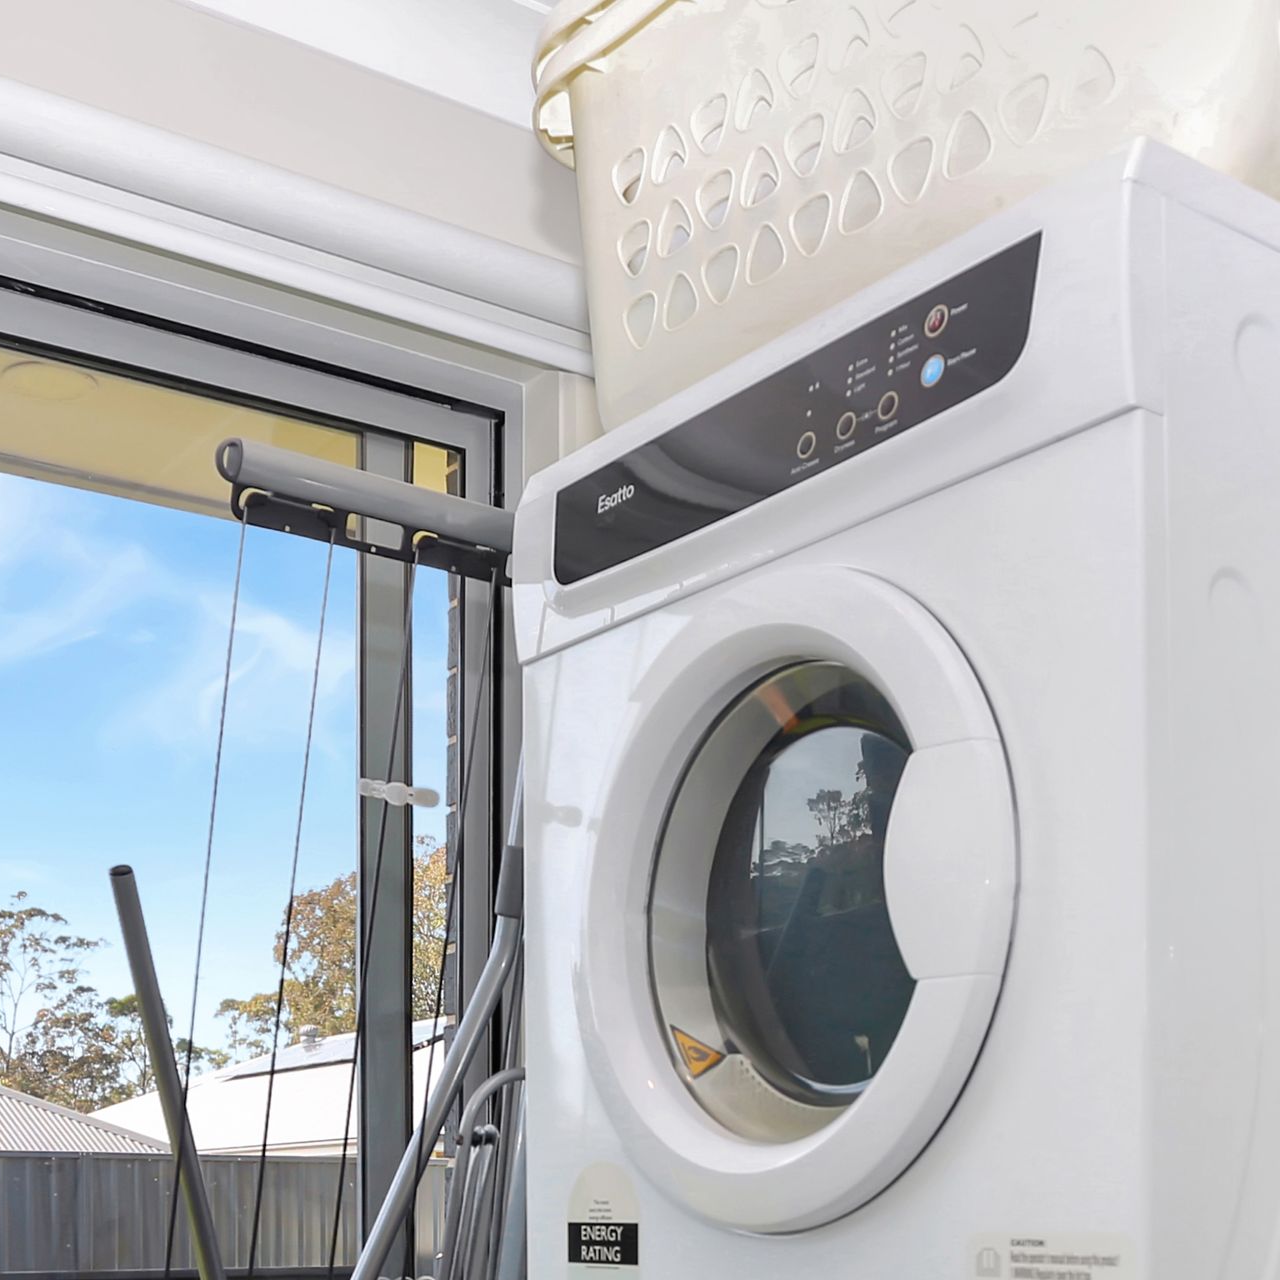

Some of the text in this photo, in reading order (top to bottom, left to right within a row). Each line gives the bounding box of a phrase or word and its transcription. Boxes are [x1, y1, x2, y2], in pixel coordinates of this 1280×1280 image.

[598, 485, 634, 514] Esatto
[580, 1224, 624, 1241] ENERGY
[580, 1246, 621, 1262] RATING
